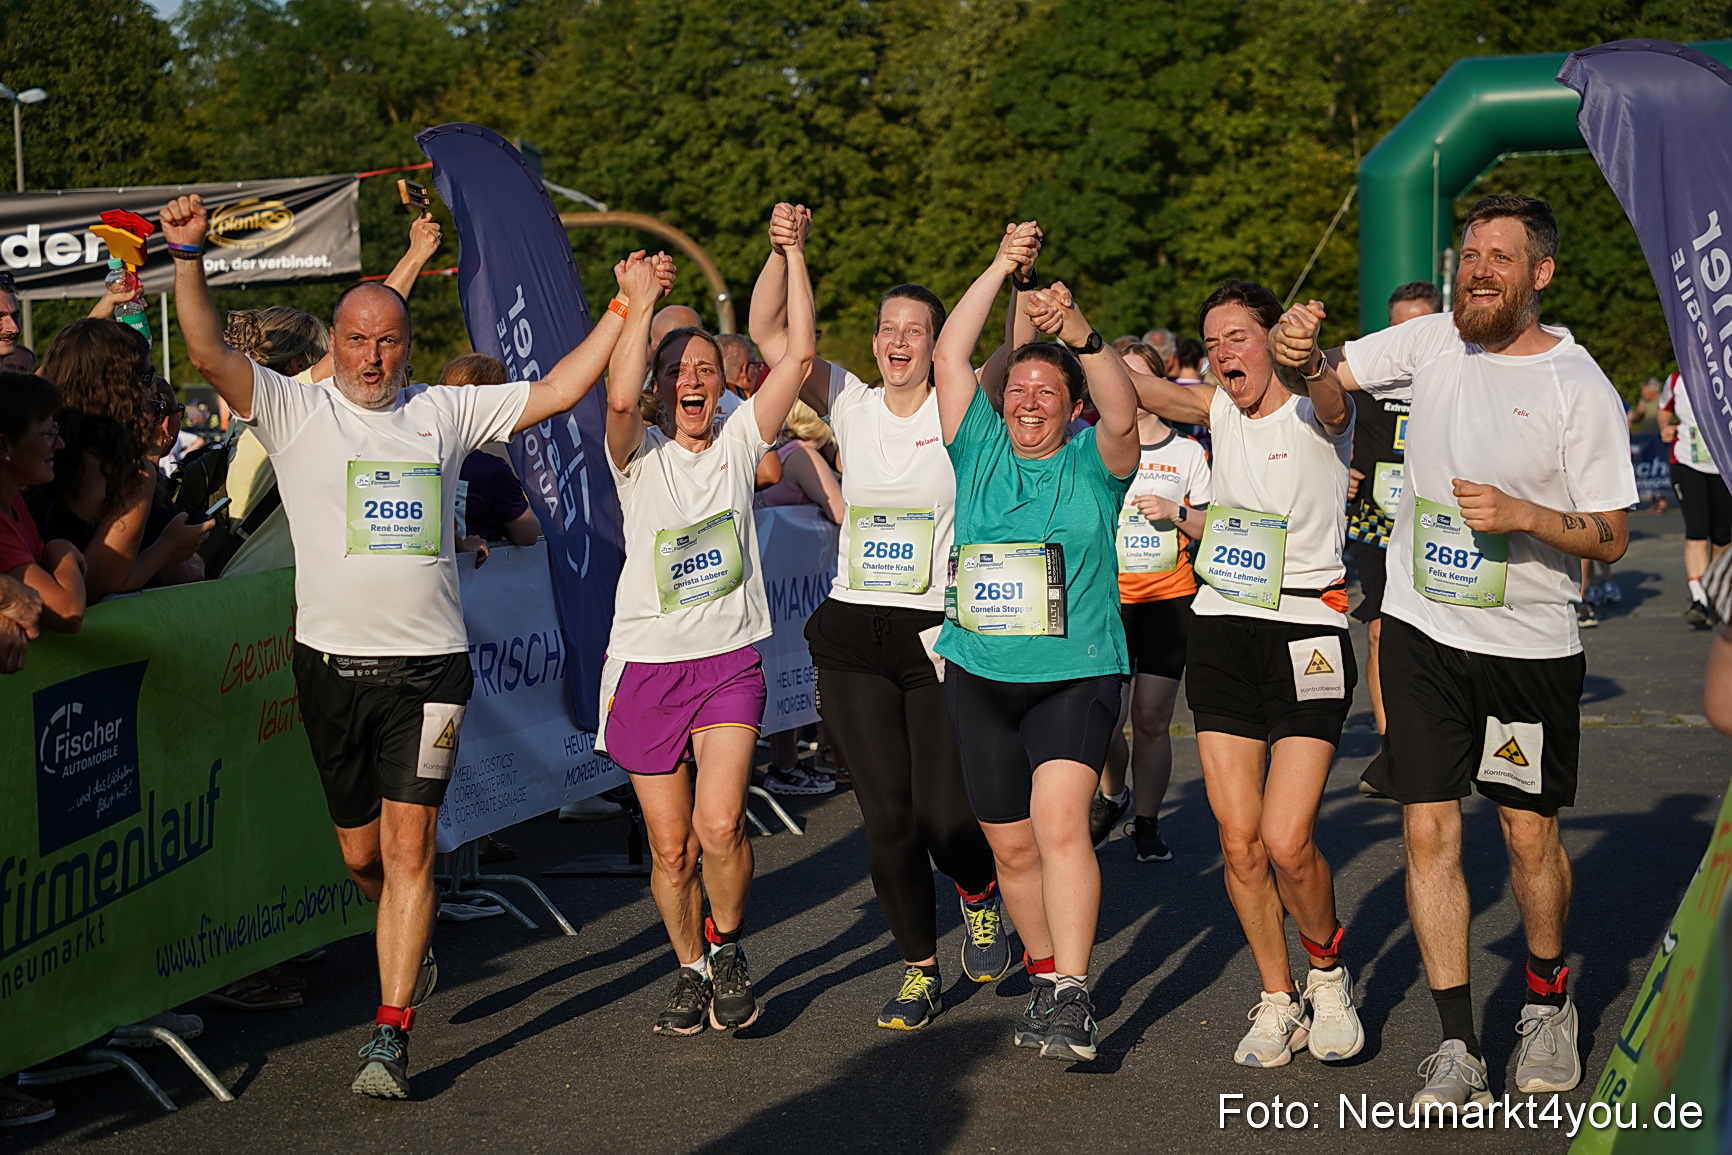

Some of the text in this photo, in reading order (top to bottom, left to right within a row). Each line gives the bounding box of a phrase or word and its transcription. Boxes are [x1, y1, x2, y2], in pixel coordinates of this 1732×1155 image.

[231, 256, 257, 271] der
[258, 254, 332, 270] verbindet.
[1512, 407, 1530, 418] Felix
[915, 435, 940, 448] Melanie
[1137, 472, 1181, 484] NAMICS
[364, 500, 423, 520] 2686
[370, 523, 421, 533] René Decker
[863, 541, 914, 560] 2688
[1123, 535, 1161, 549] 1298
[670, 548, 723, 580] 2689
[862, 562, 915, 572] Charlotte Krahl
[1212, 545, 1266, 571] 2690
[1424, 541, 1485, 571] 2687
[673, 577, 700, 591] Christa
[700, 569, 729, 582] Laberer
[1208, 566, 1232, 579] Katrin
[1233, 571, 1268, 584] Lehmeier
[1428, 566, 1447, 579] Felix
[1448, 571, 1479, 585] Kempf
[973, 582, 1024, 601] 2691
[970, 605, 1033, 614] Cornelia Stepper
[776, 666, 803, 690] HEUTE
[1300, 685, 1341, 694] Kontrollbereich
[776, 693, 812, 717] MORGEN
[55, 717, 123, 764] Fischer
[564, 732, 595, 757] HEUTE
[62, 744, 119, 778] AUTOMOBILE
[564, 758, 600, 788] MORGEN
[1483, 768, 1536, 787] Kontrollbereich
[76, 786, 91, 808] und
[92, 778, 107, 795] das
[454, 776, 496, 804] CORPORATE
[455, 796, 497, 824] CORPORATE
[0, 758, 223, 957] firmenlauf
[156, 877, 374, 978] www.firmenlauf-oberp
[1, 914, 105, 998] neumarkt
